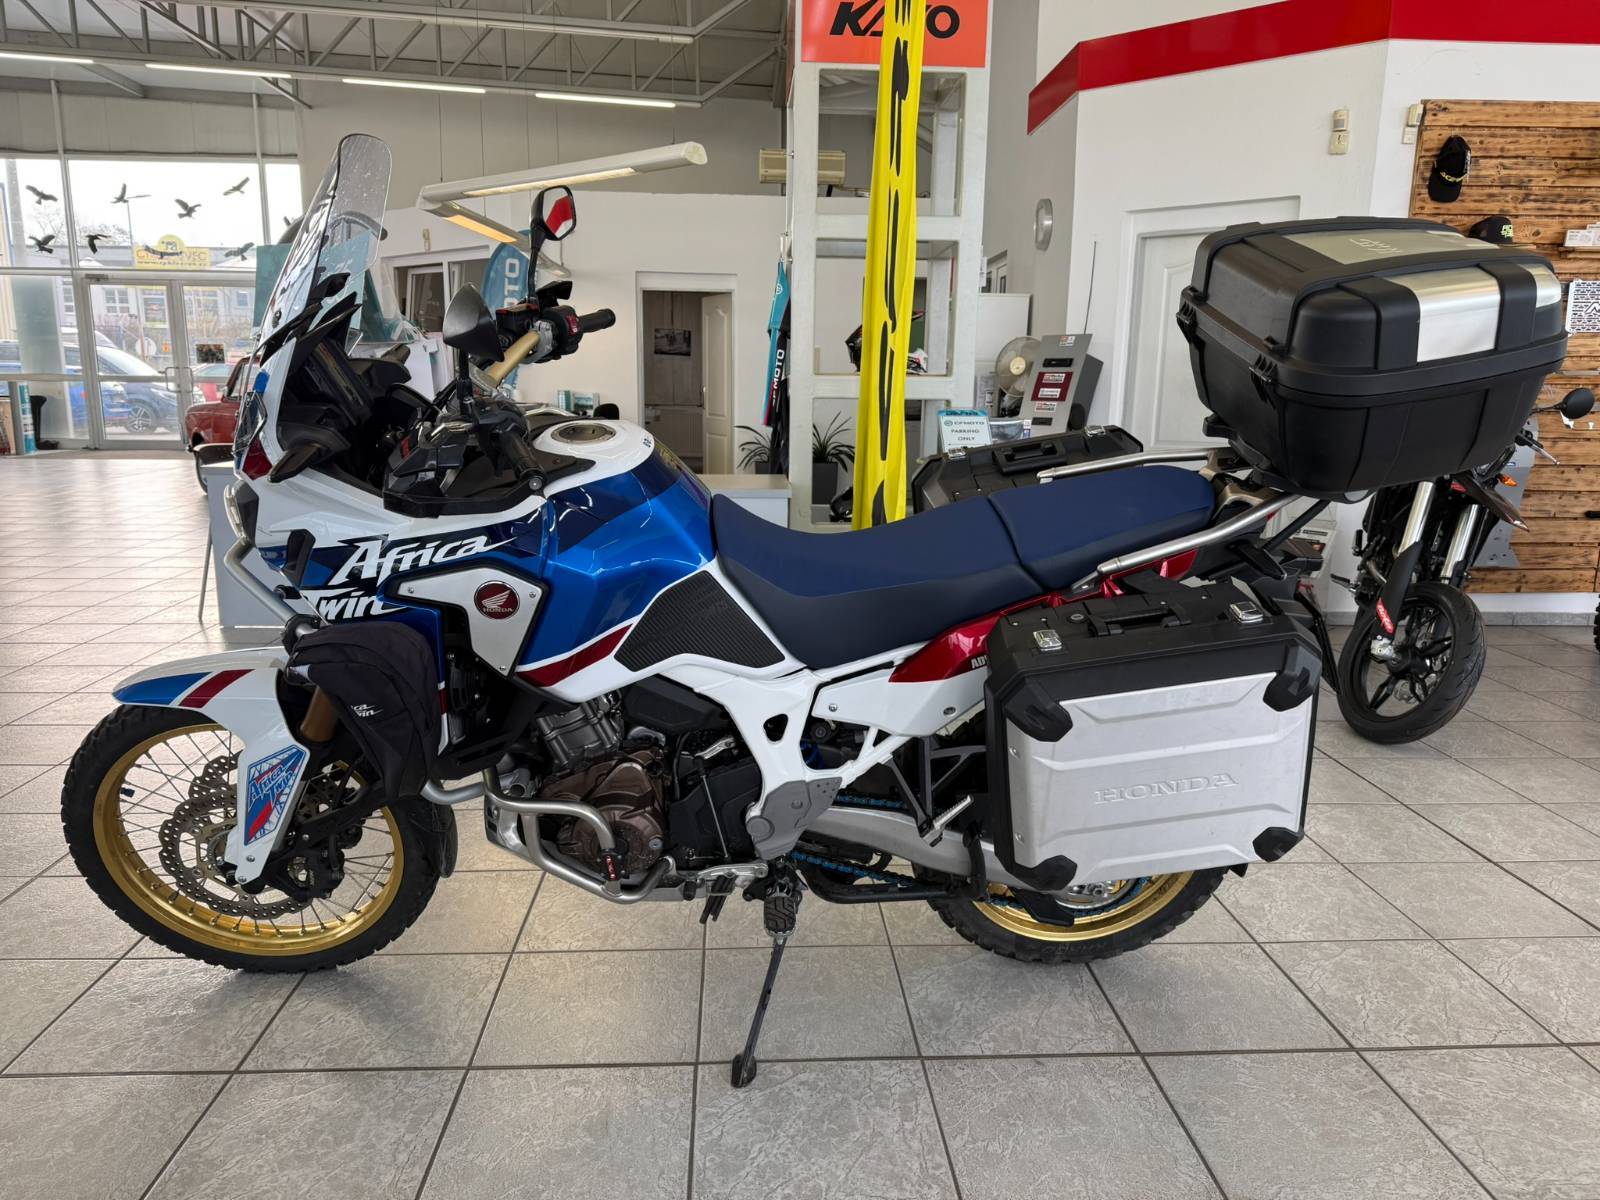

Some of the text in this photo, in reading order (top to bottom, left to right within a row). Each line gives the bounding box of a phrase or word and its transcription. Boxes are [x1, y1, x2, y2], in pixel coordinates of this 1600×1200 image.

[830, 0, 960, 39] KAO
[327, 535, 517, 587] Africa
[300, 588, 407, 621] Twin
[1094, 772, 1239, 805] HONDA
